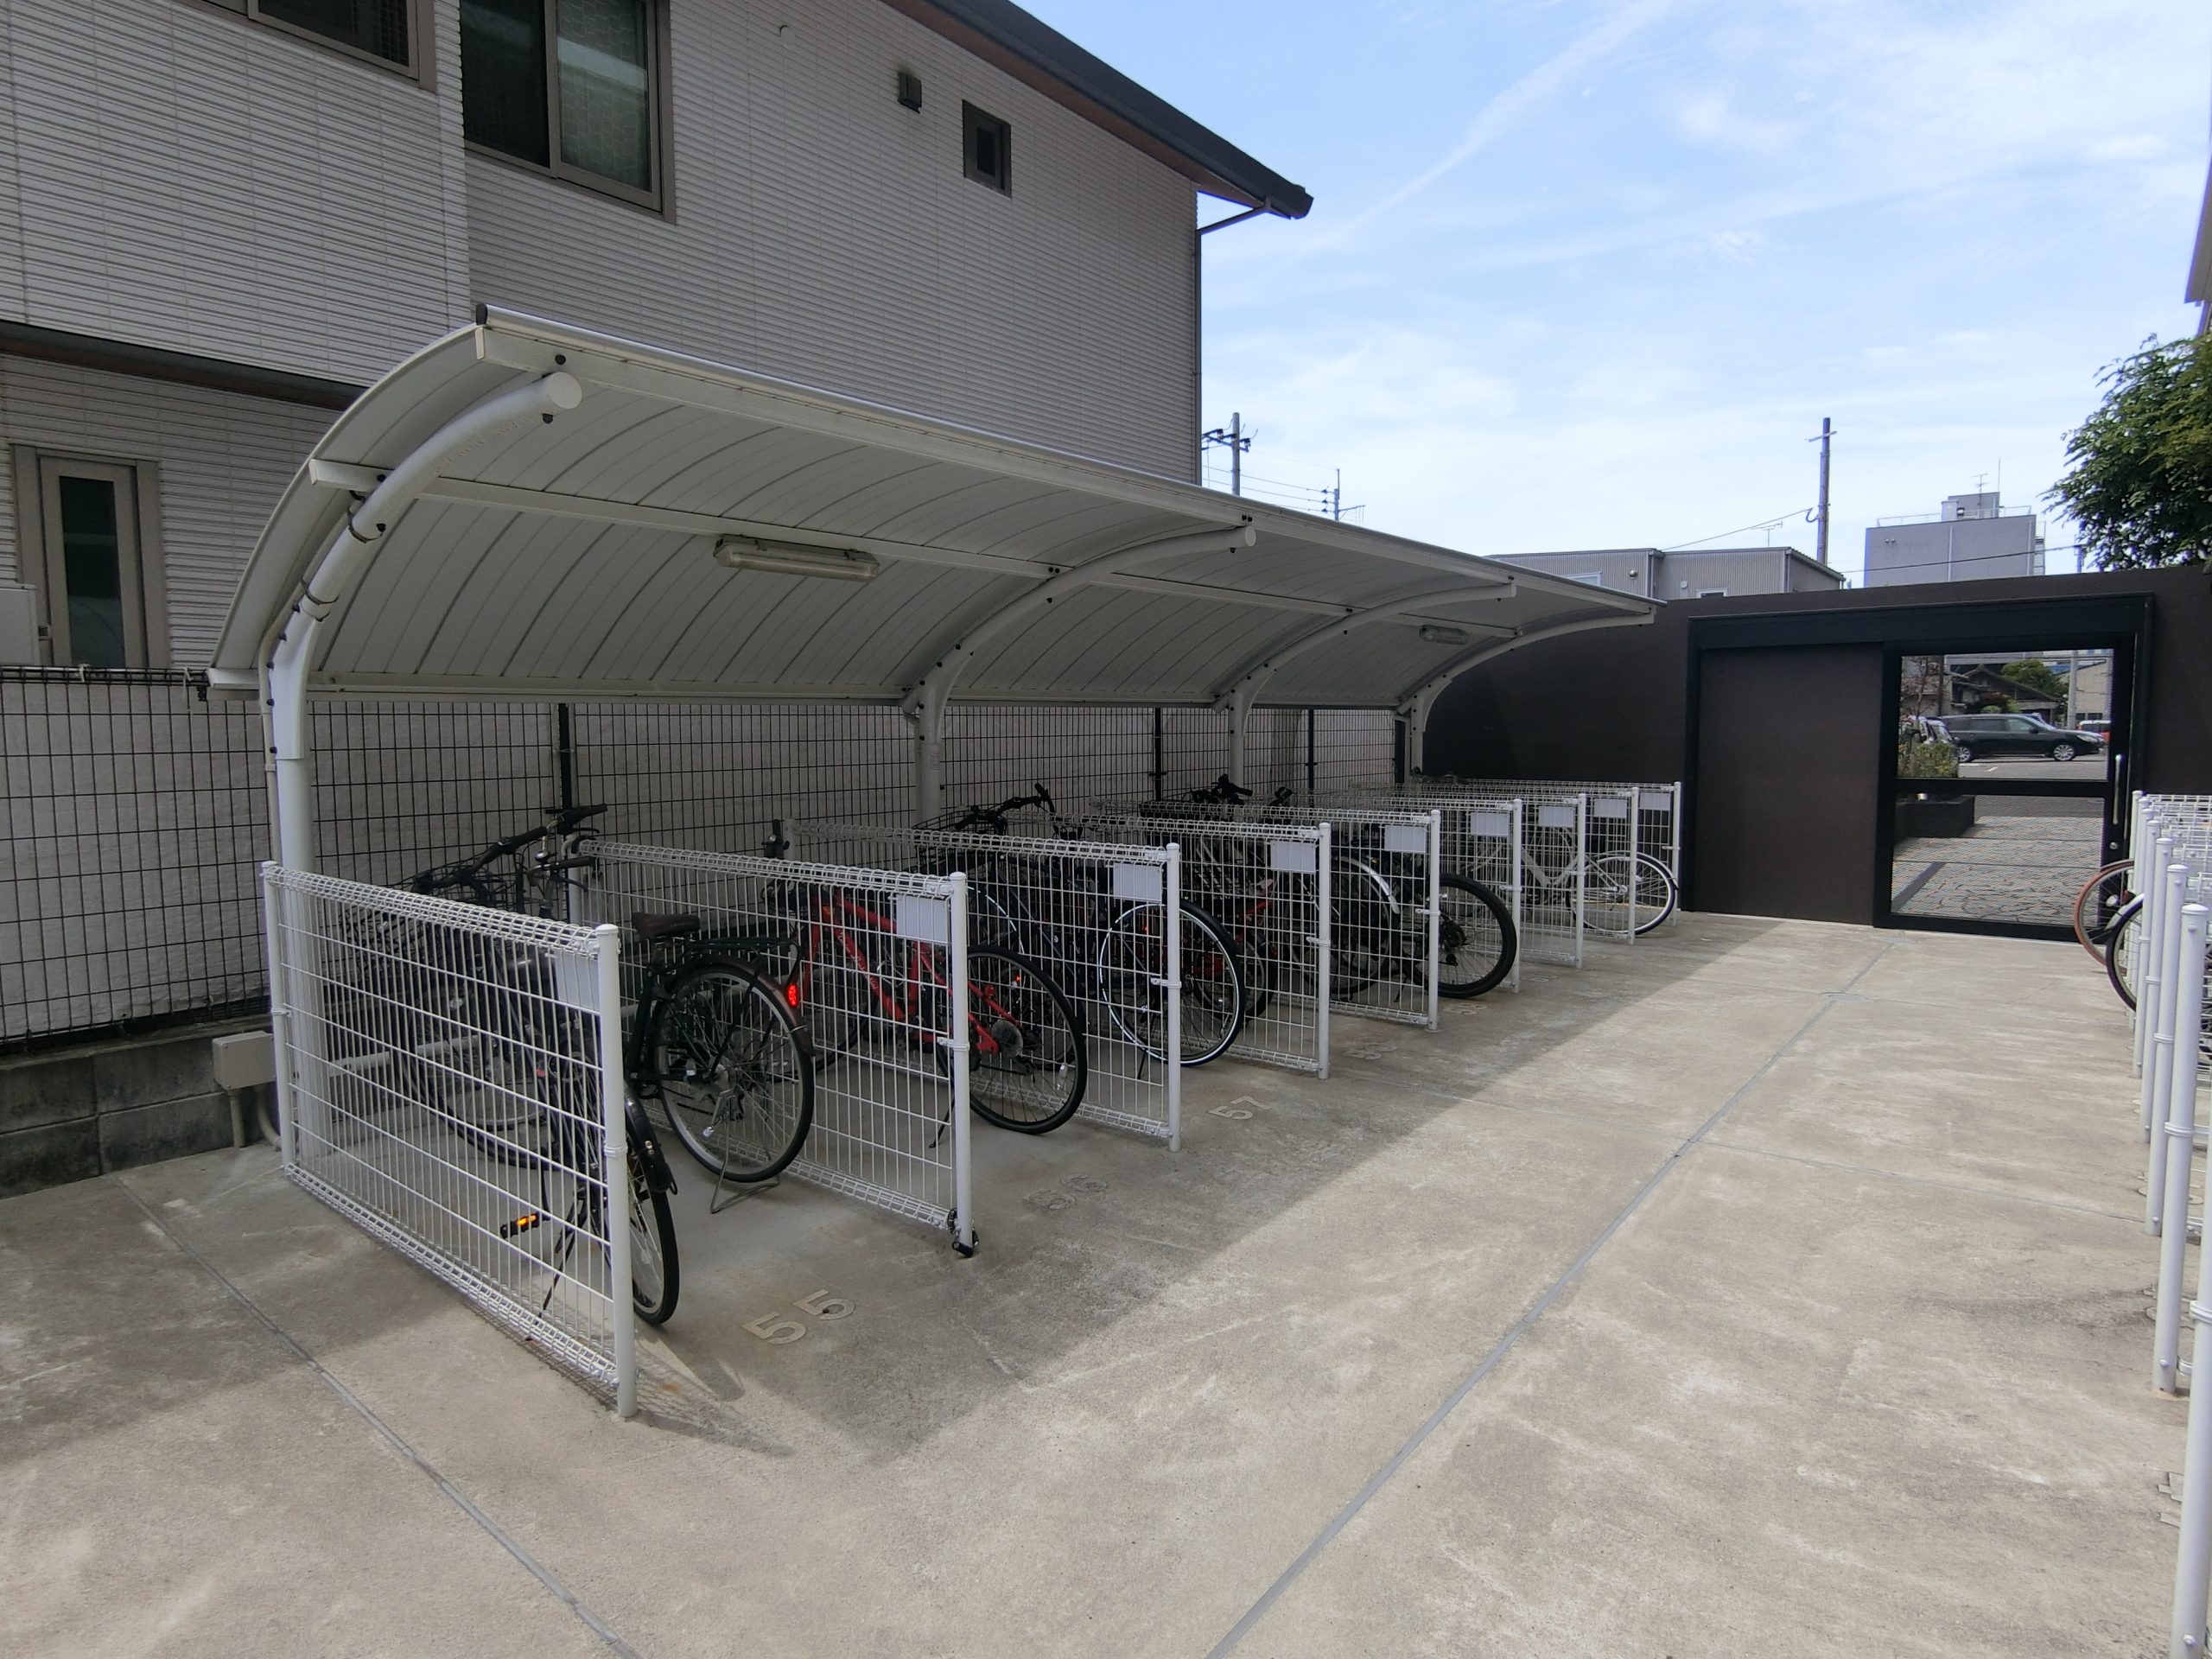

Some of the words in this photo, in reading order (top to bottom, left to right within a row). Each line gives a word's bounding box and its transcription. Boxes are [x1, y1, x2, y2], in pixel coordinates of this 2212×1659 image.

[1207, 1096, 1272, 1120] 57
[1023, 1175, 1108, 1210] 56
[742, 1288, 855, 1344] 55
